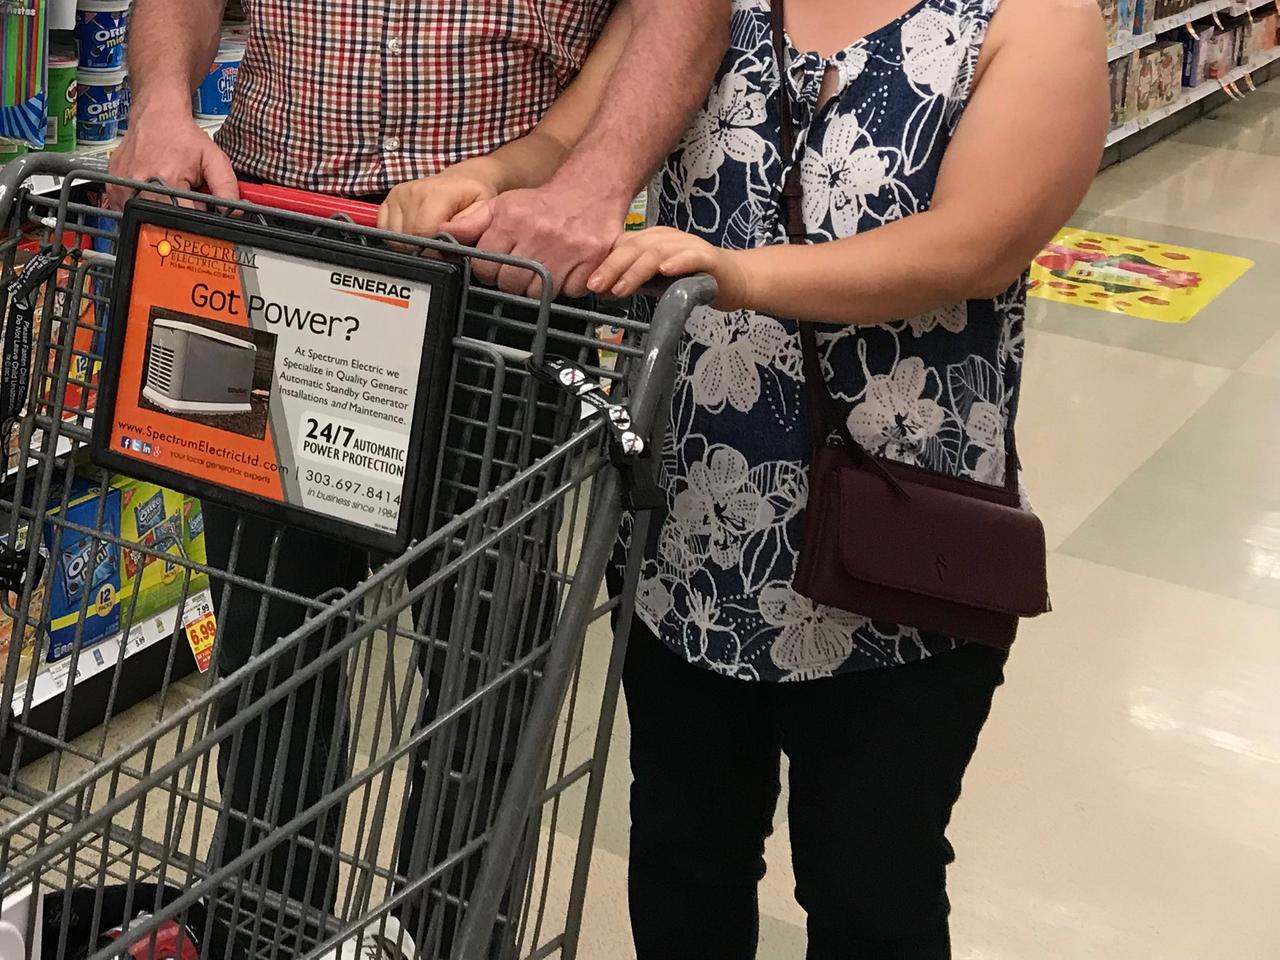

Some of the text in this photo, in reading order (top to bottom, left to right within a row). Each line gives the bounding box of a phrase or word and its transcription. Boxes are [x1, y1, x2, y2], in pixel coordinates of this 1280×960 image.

[172, 235, 257, 267] SPECTRUM
[223, 262, 236, 273] Ltd
[329, 271, 411, 300] GENERAC
[190, 282, 360, 342] Got Power?
[282, 358, 408, 396] Specialize in Quality Generac
[294, 346, 399, 379] At Spectrum Electric we
[279, 371, 409, 411] Automatic Standby Generator
[279, 386, 406, 425] Installations and Maintenance.
[118, 420, 289, 475] www.SpectrumElectricLtd.com
[303, 440, 404, 478] POWER PROTECTION
[305, 418, 404, 462] 24/7 AUTOMATIC
[171, 450, 271, 484] your local generator experts
[305, 468, 401, 506] 303.697.8414
[308, 487, 398, 520] in business since 1984
[190, 620, 216, 645] 6.99
